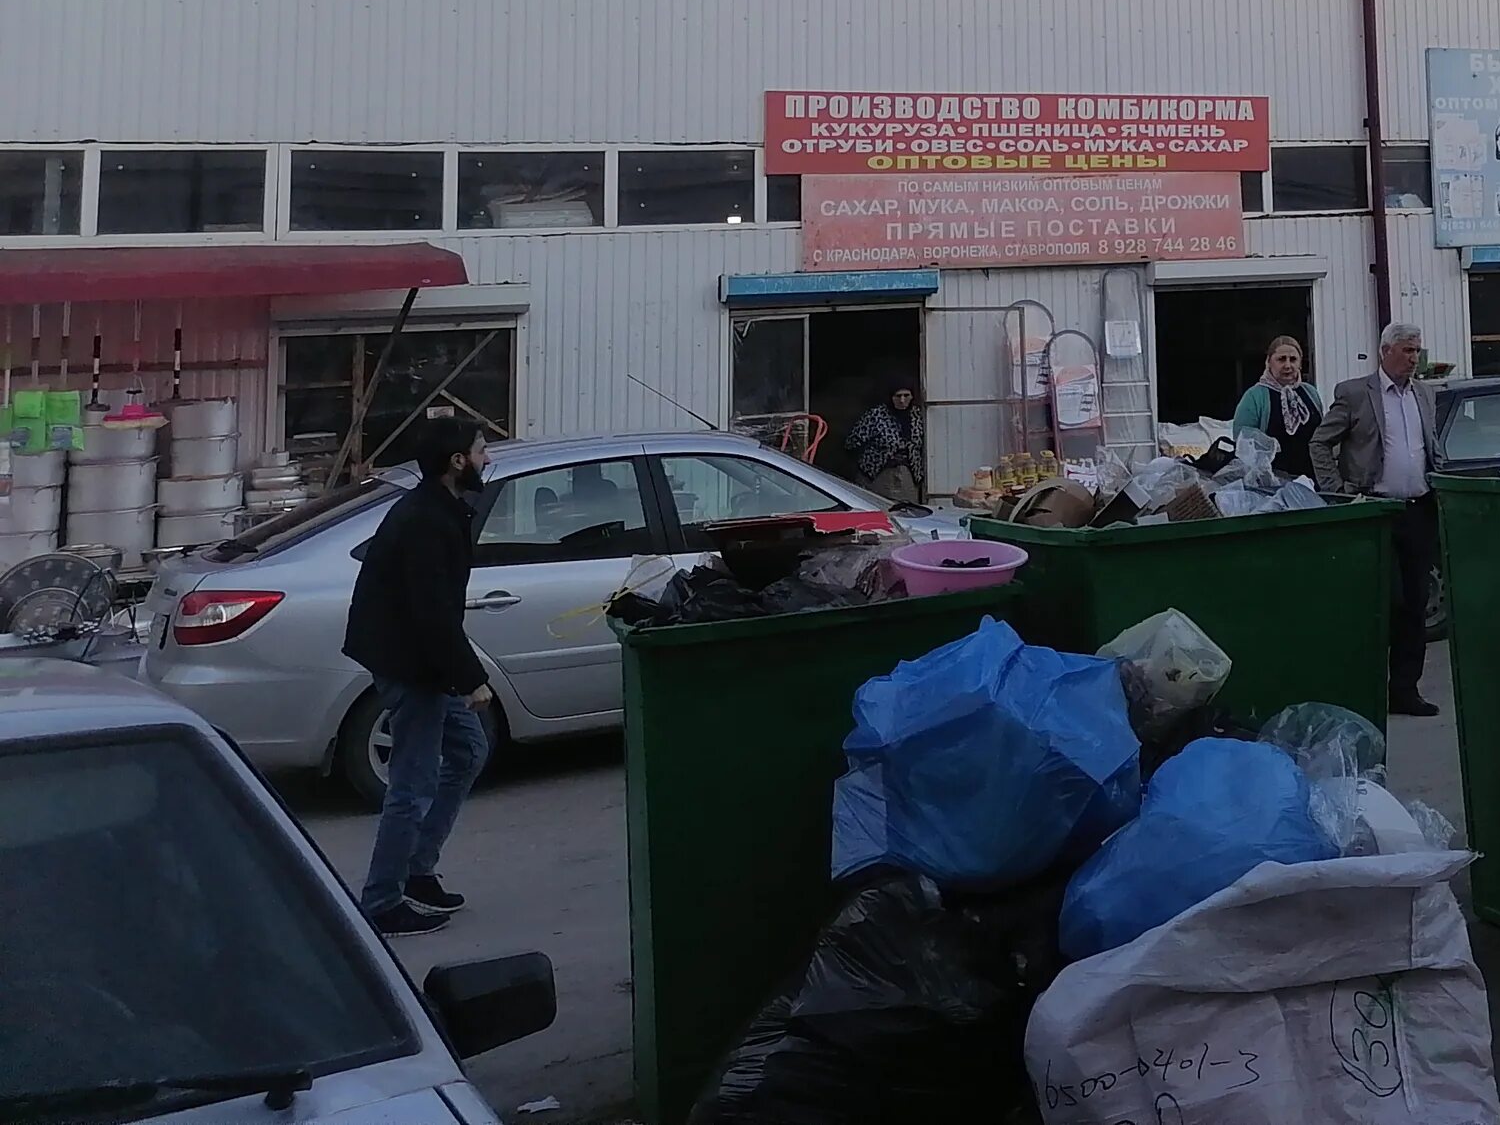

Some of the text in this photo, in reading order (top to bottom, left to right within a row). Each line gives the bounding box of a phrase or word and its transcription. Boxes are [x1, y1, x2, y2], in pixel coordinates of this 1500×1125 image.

[785, 95, 1255, 122] ПРОИЗВОДСТВО КОМБИКОРМА
[1435, 97, 1498, 111] ОПТОМ
[811, 122, 1226, 138] КУКУРУЗА ПШЕНИЦА ЯЧМЕНЬ
[781, 139, 1249, 153] ОТРУБИ ОВЕС СОЛЬ МУКА САХАР
[866, 154, 1167, 170] ОПТОВЫЕ ЦЕНЫ
[899, 178, 1162, 193] ПО САМЫМ НИЗКИМ ОПТОВЫМ ЦЕНАМ
[820, 194, 1230, 218] САХАР, МУКА, МАКФА, СОЛЬ, ДРОЖЖИ
[886, 217, 1177, 241] ПРЯМЫЕ ПОСТАВКИ
[813, 242, 1090, 263] С КРАСНОДАРА, ВОРОНЕЖА, СТАВРОПОЛЯ
[1098, 235, 1237, 254] 8 928 744 28 46
